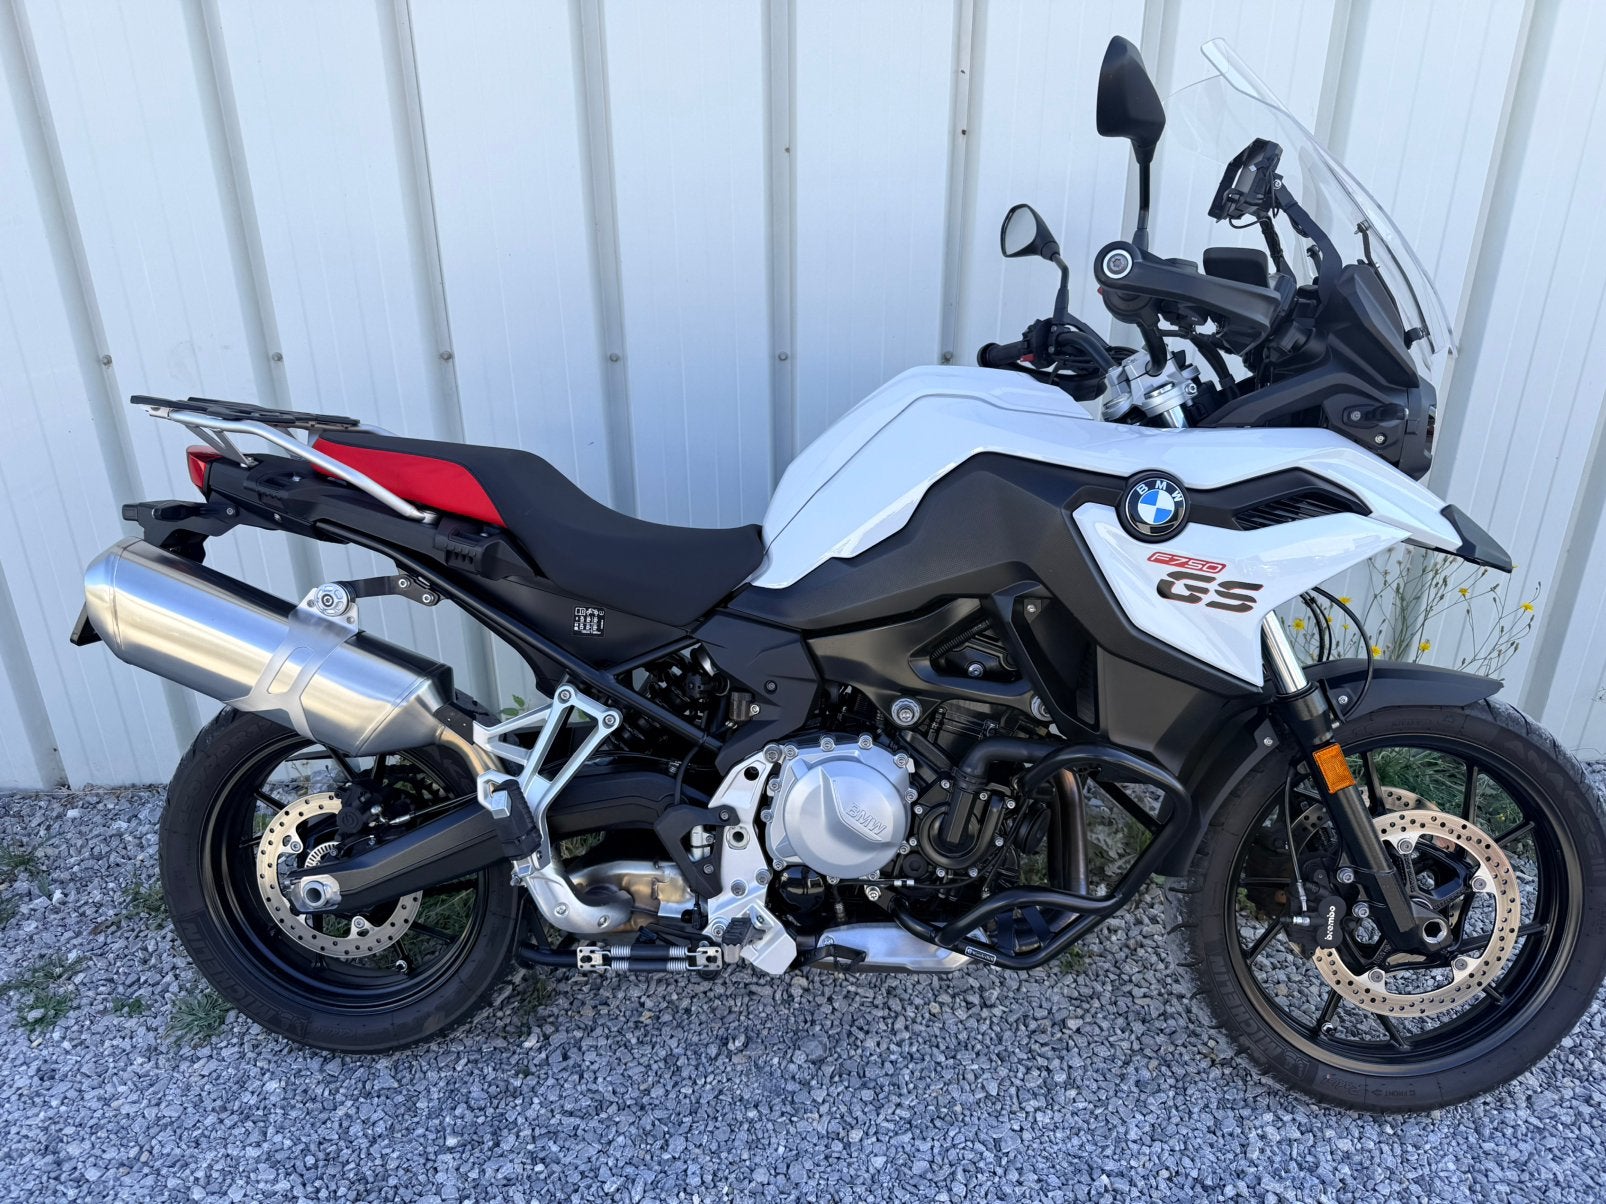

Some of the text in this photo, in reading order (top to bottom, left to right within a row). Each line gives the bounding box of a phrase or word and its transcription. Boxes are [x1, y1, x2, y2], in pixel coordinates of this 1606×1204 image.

[1137, 481, 1182, 502] BMW
[1150, 553, 1224, 572] F750
[1156, 571, 1264, 613] GS
[1502, 741, 1602, 856] ANAKEE
[848, 803, 888, 835] BMW
[1324, 905, 1336, 940] brembo
[181, 921, 279, 1021] MICHELIN
[1205, 952, 1285, 1060] MICHELIN
